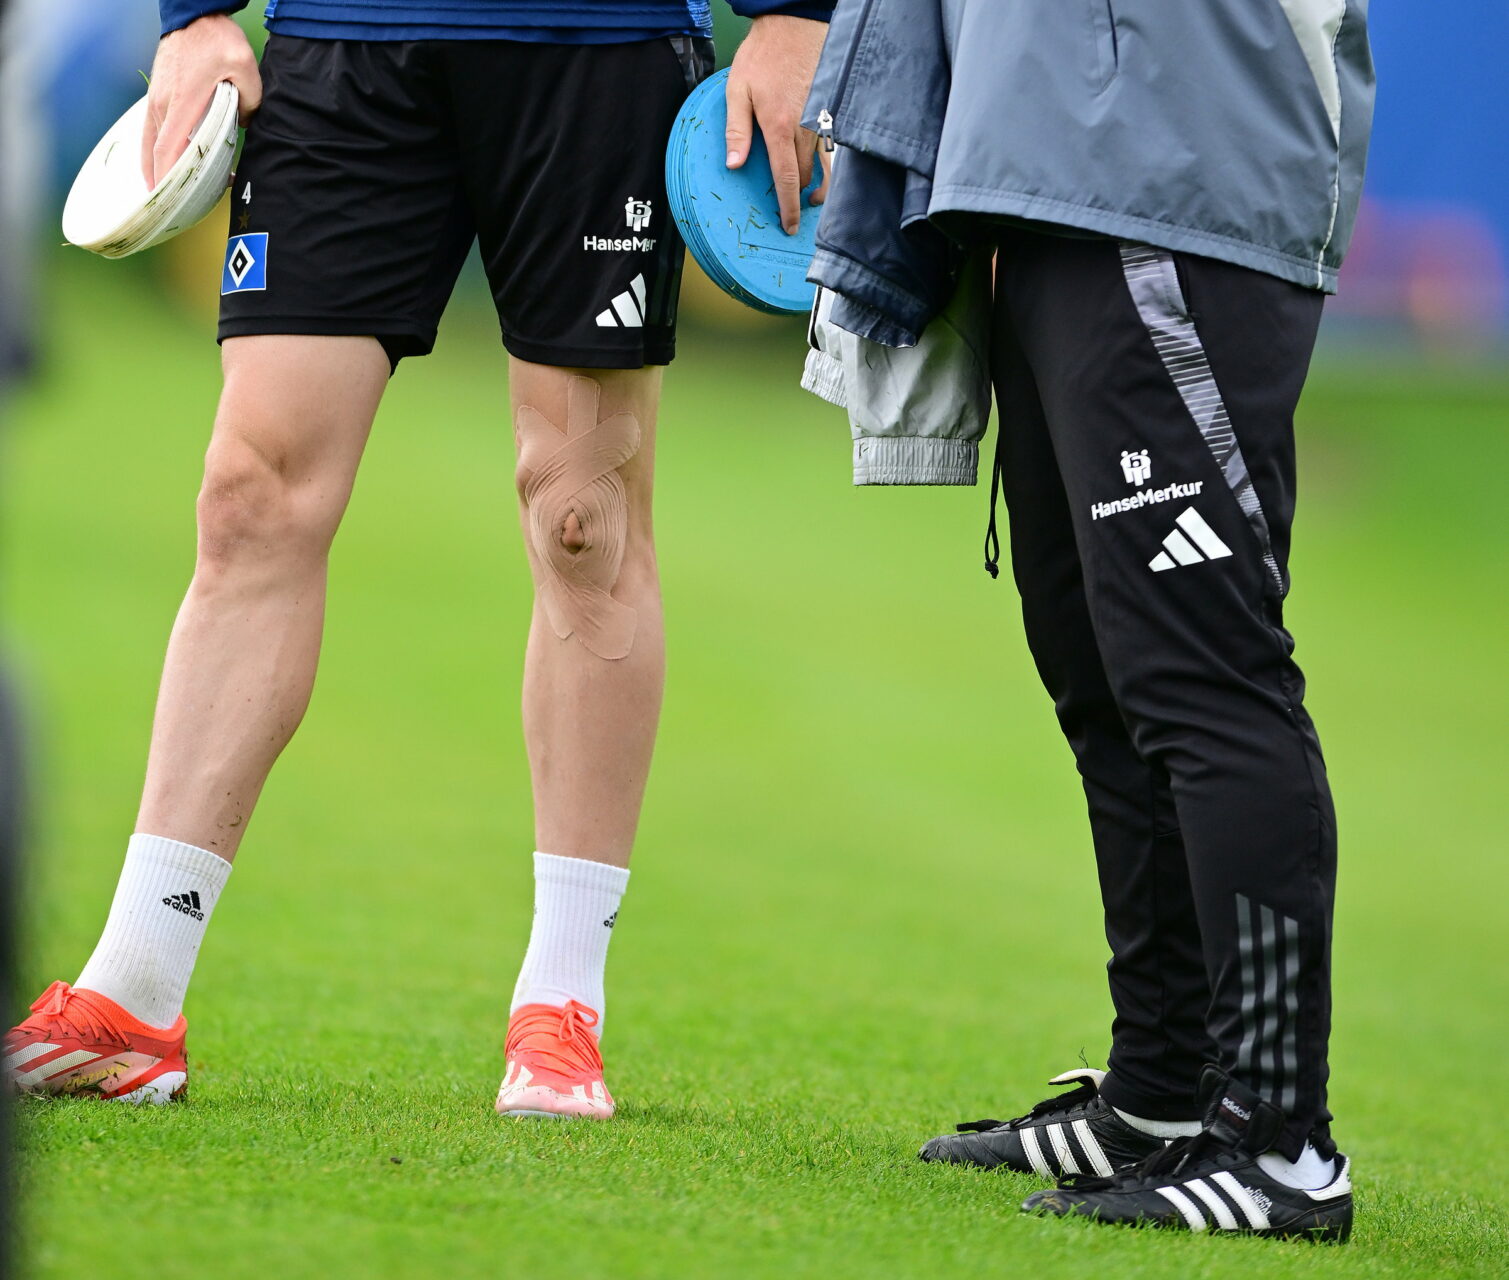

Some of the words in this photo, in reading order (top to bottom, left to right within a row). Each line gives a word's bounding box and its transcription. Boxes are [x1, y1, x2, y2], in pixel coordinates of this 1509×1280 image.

[241, 181, 252, 205] 4
[1091, 481, 1204, 521] HanseMerkur
[162, 897, 205, 921] adidas
